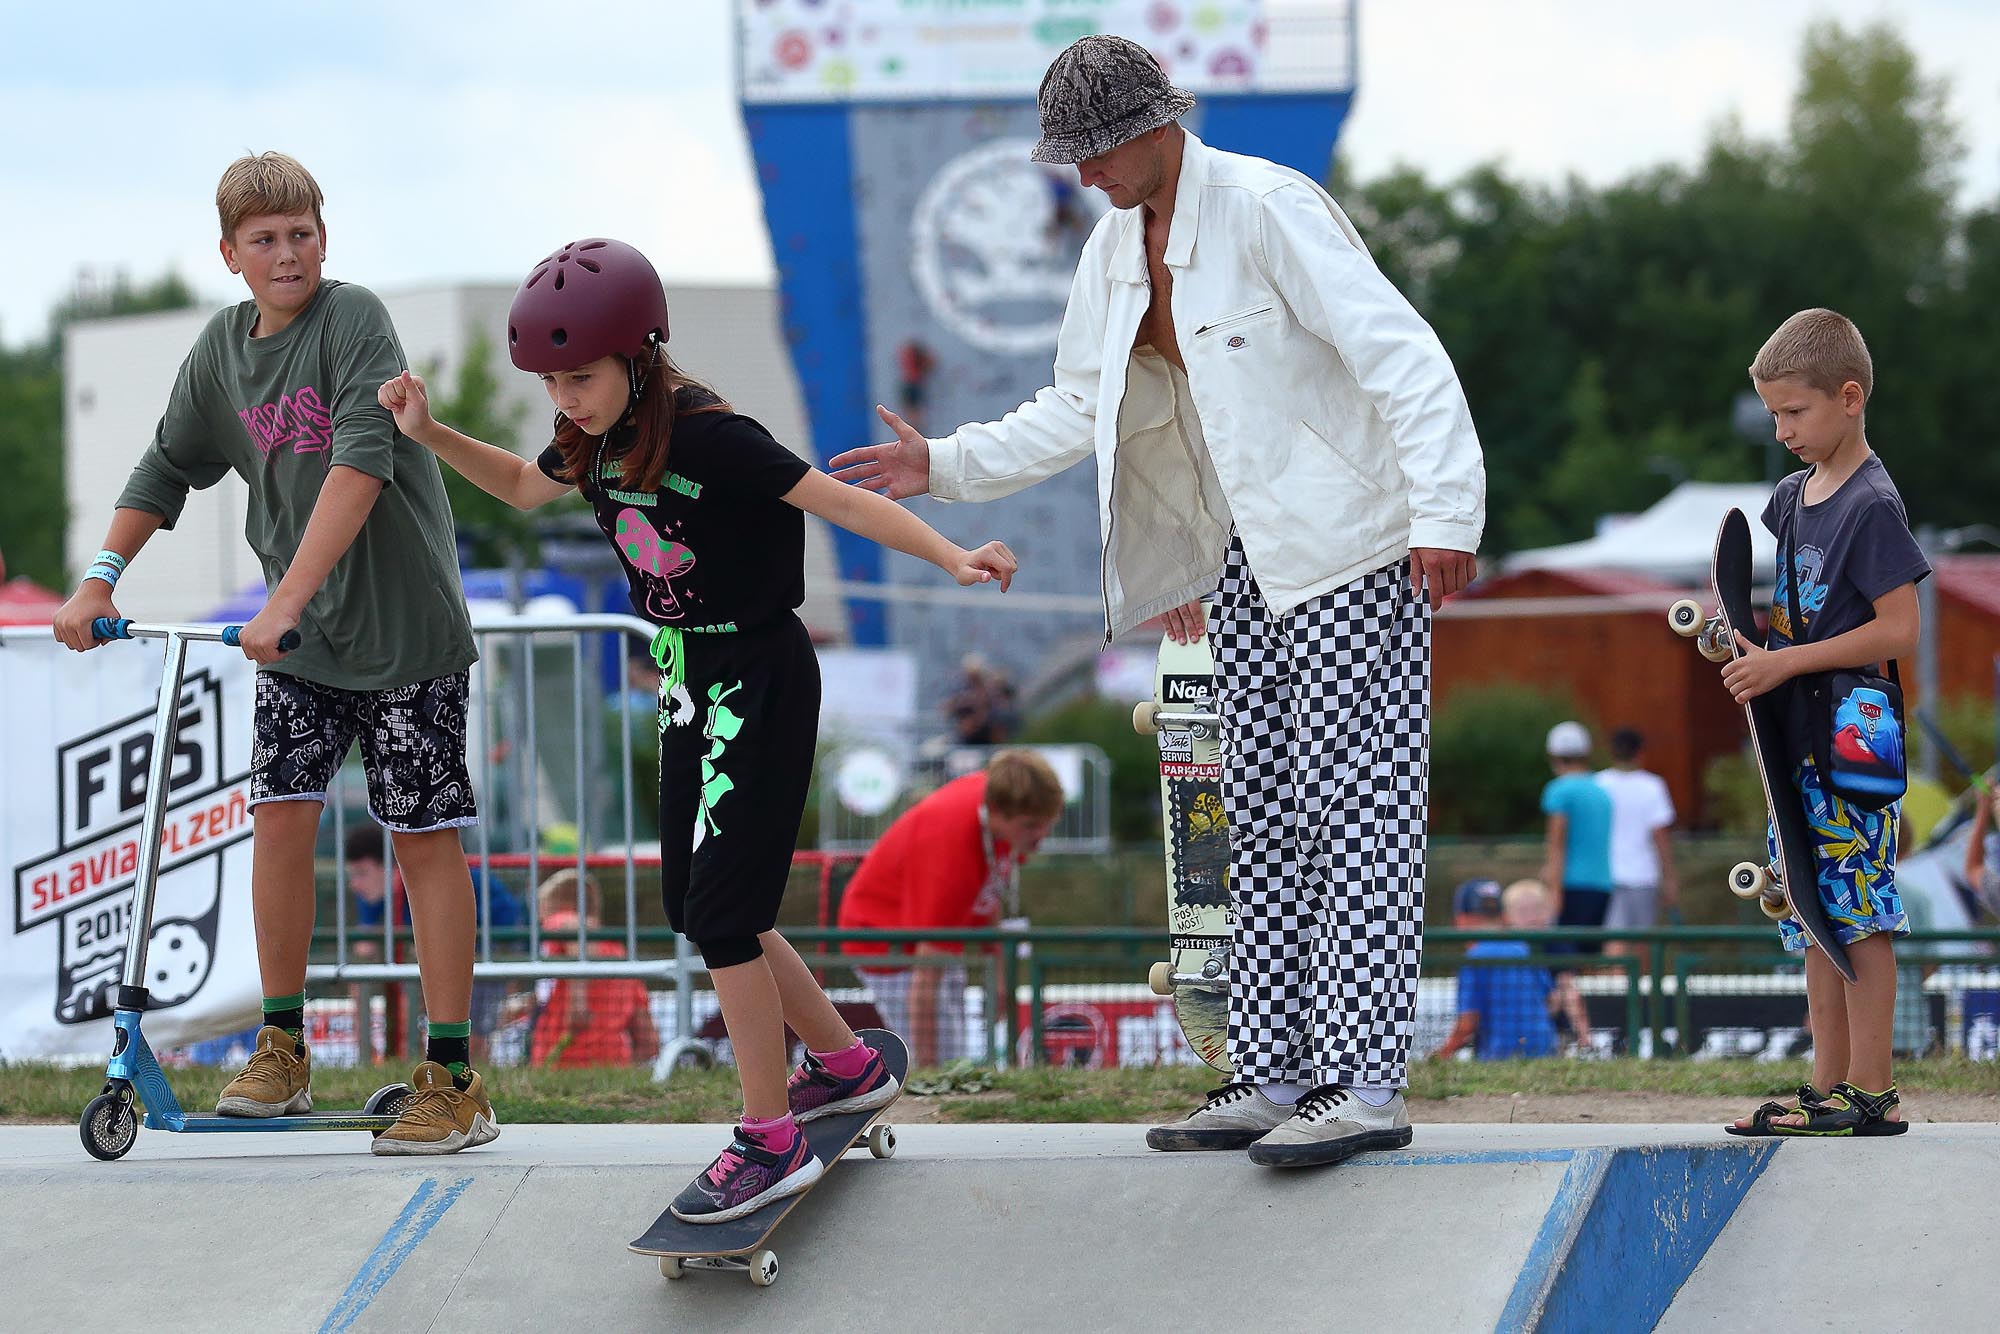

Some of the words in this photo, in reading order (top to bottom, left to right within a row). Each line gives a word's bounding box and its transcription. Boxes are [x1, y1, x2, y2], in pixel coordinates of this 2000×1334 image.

[1161, 751, 1192, 763] SERVIS
[1177, 915, 1200, 933] MOST
[1173, 938, 1221, 950] SPITFIRE
